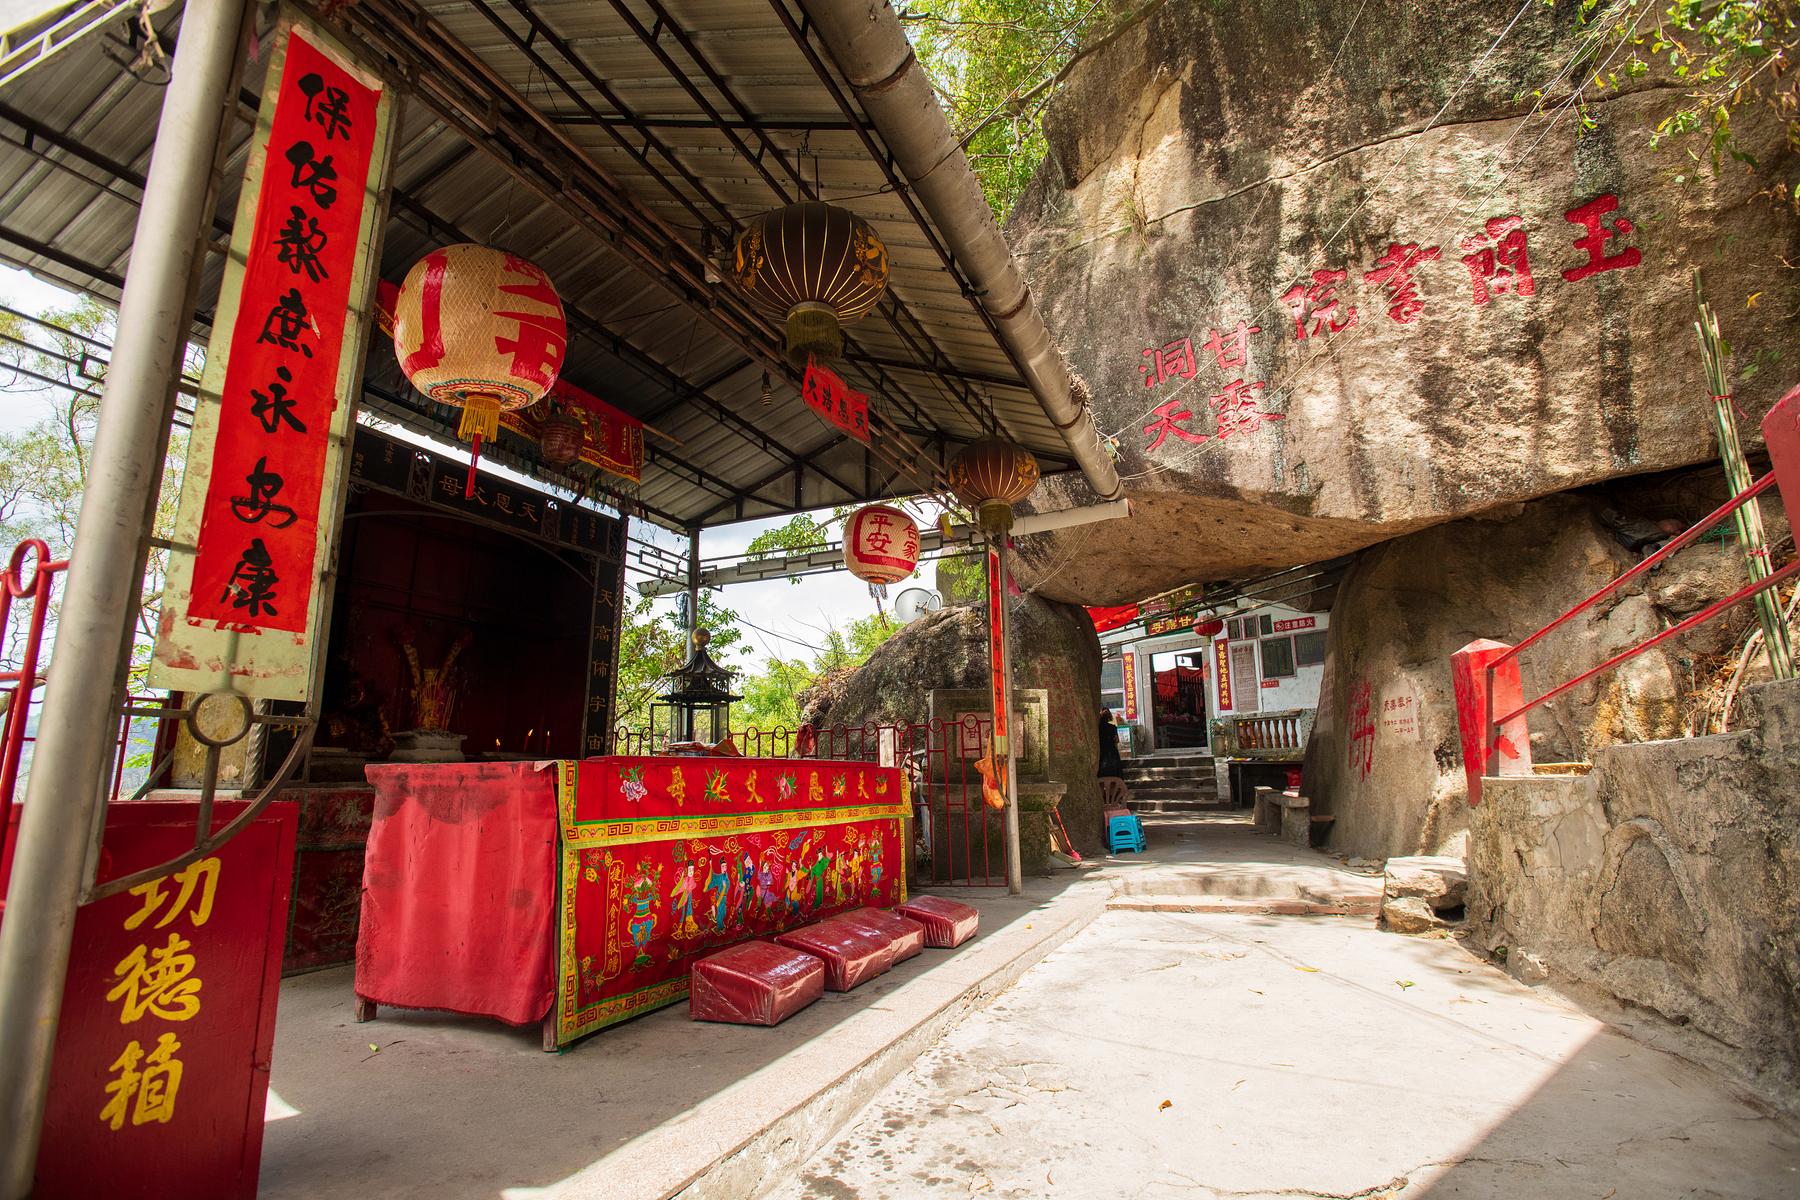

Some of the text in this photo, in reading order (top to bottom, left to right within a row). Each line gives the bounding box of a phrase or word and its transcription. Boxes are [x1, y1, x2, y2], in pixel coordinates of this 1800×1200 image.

[866, 514, 894, 554] 平安
[99, 856, 222, 1131] 功德箱
